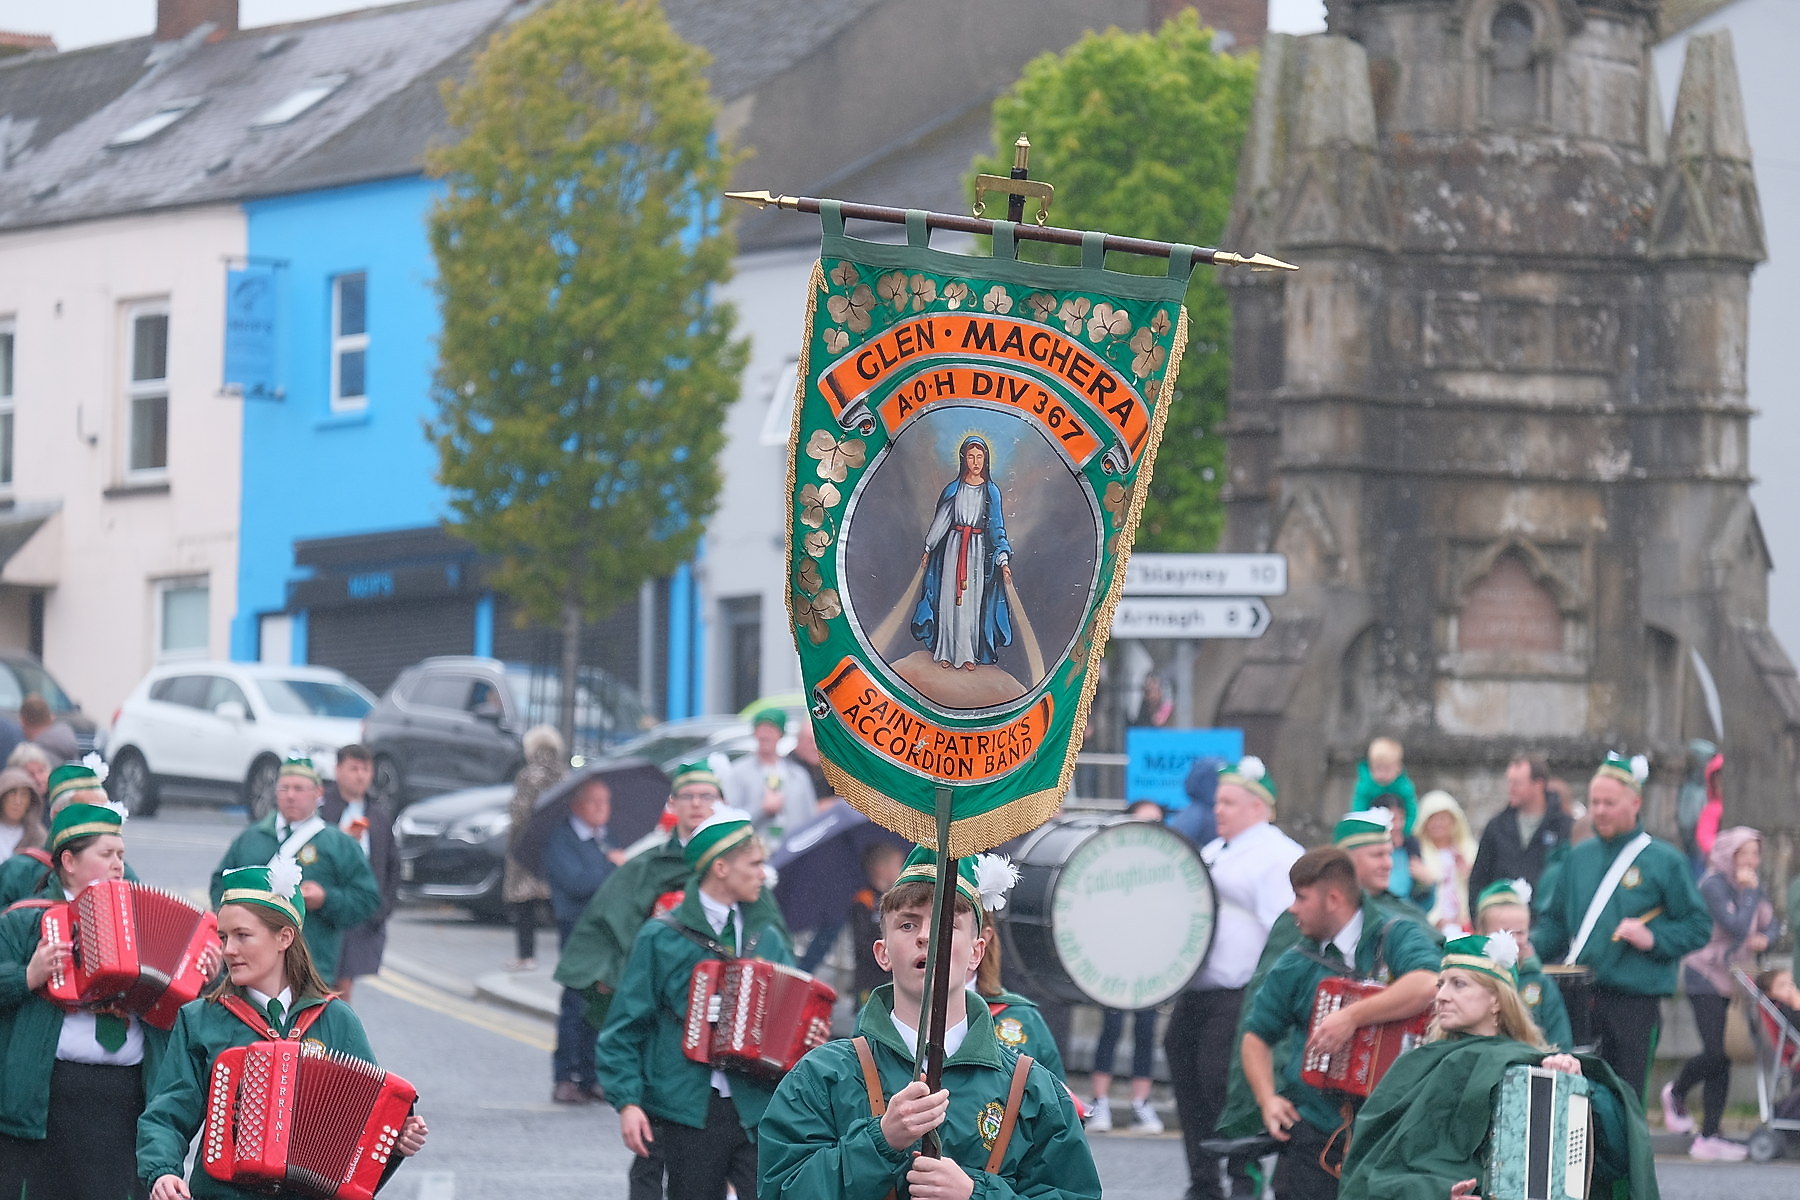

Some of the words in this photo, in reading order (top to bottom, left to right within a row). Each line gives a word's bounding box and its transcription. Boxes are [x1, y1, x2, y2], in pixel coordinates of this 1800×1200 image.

[856, 320, 934, 380] GLEN
[961, 319, 1136, 429] MAGHERA
[971, 372, 1030, 403] DIV
[1032, 390, 1084, 441] 367
[1251, 564, 1277, 584] 10
[1121, 608, 1203, 630] Armagh
[1226, 609, 1240, 625] 8
[841, 704, 974, 777] ACCORDION
[984, 737, 1032, 774] BAND
[858, 687, 927, 740] SAINT
[933, 716, 1032, 755] PATRICK'S
[118, 885, 131, 951] GUERRINI
[276, 1052, 291, 1143] GUERRINI
